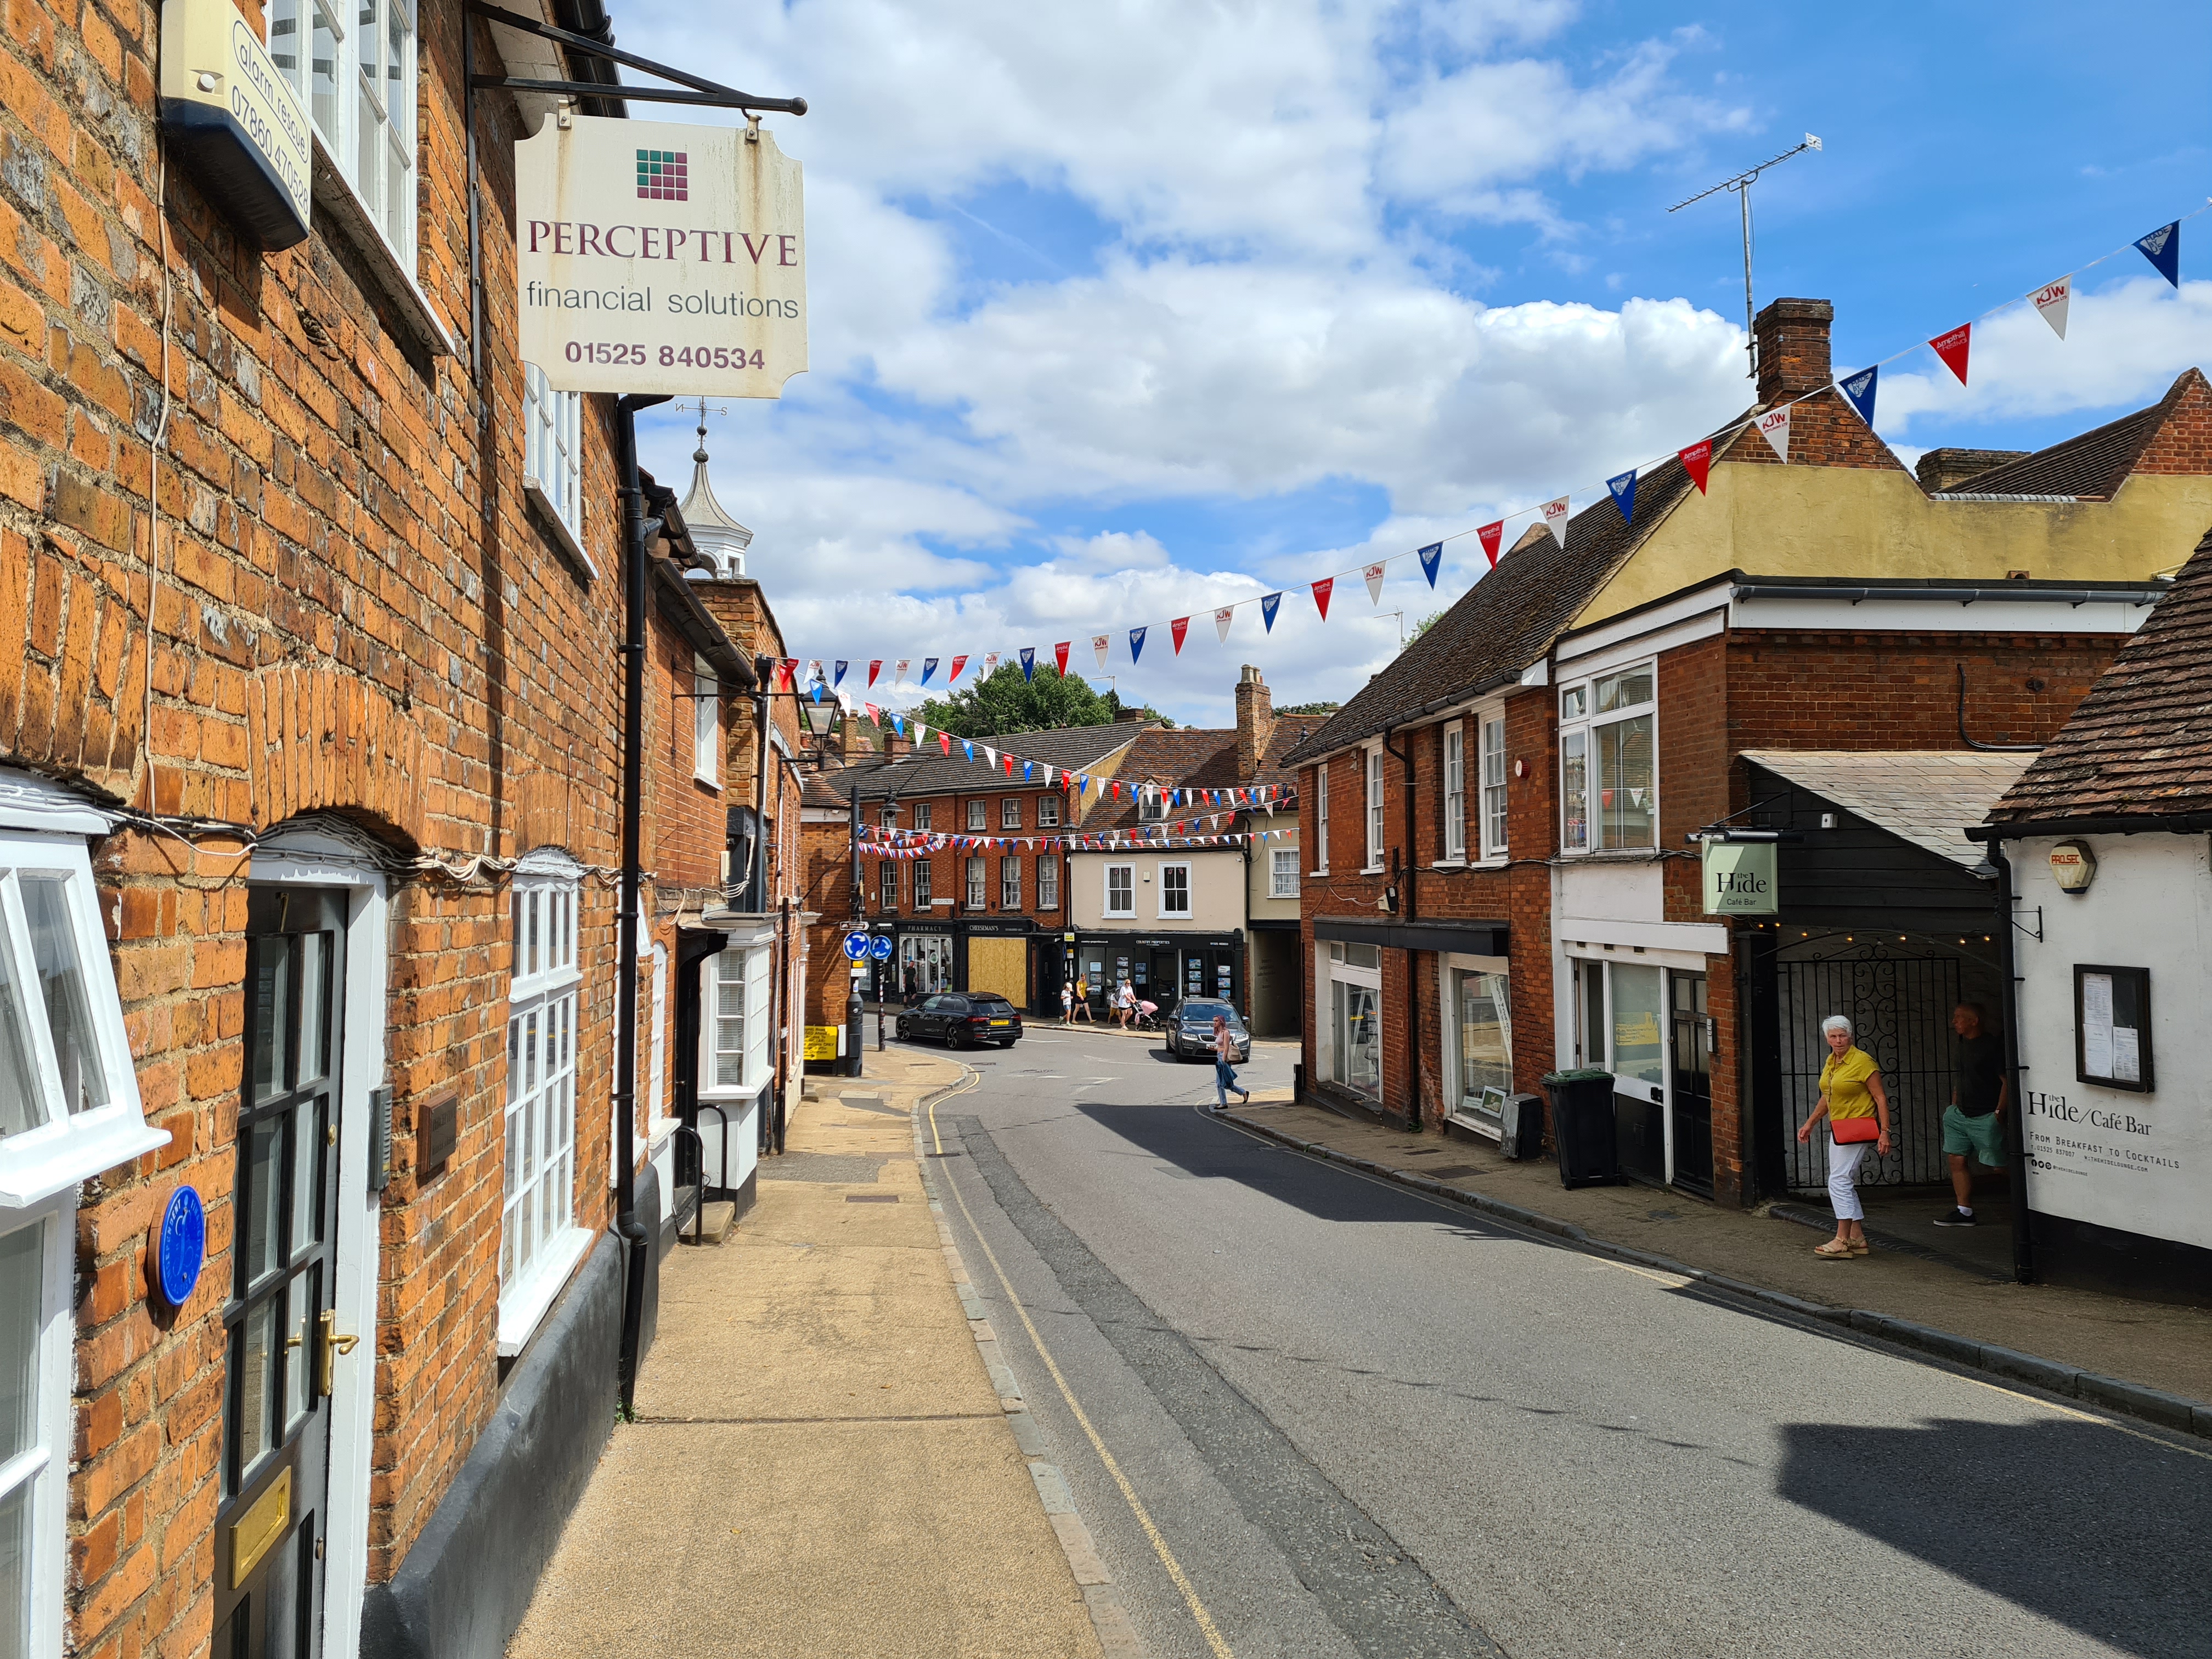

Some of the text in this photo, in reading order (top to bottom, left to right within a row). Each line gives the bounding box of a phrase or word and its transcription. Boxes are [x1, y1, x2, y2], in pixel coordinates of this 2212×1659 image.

[240, 41, 307, 156] alarm rescue
[232, 84, 309, 216] 07860 470528
[2145, 227, 2170, 240] MADE
[526, 220, 798, 267] PERCEPTIVE
[527, 281, 799, 318] financial solutions
[2036, 286, 2065, 304] KJW
[1937, 330, 1966, 348] Ampthill
[1942, 337, 1968, 351] Festival
[565, 341, 765, 370] 01525 840534
[1852, 375, 1870, 385] MADE
[1763, 413, 1785, 429] KJW
[1684, 445, 1708, 459] Ampthill
[1546, 502, 1565, 516] KJW
[1366, 566, 1382, 577] KJW
[1217, 609, 1231, 619] KJW
[1716, 872, 1767, 893] Hide
[2049, 1094, 2060, 1102] the
[2125, 1115, 2152, 1136] Bar
[2056, 1148, 2075, 1158] 837007
[165, 1198, 181, 1285] INDEPENDENT
